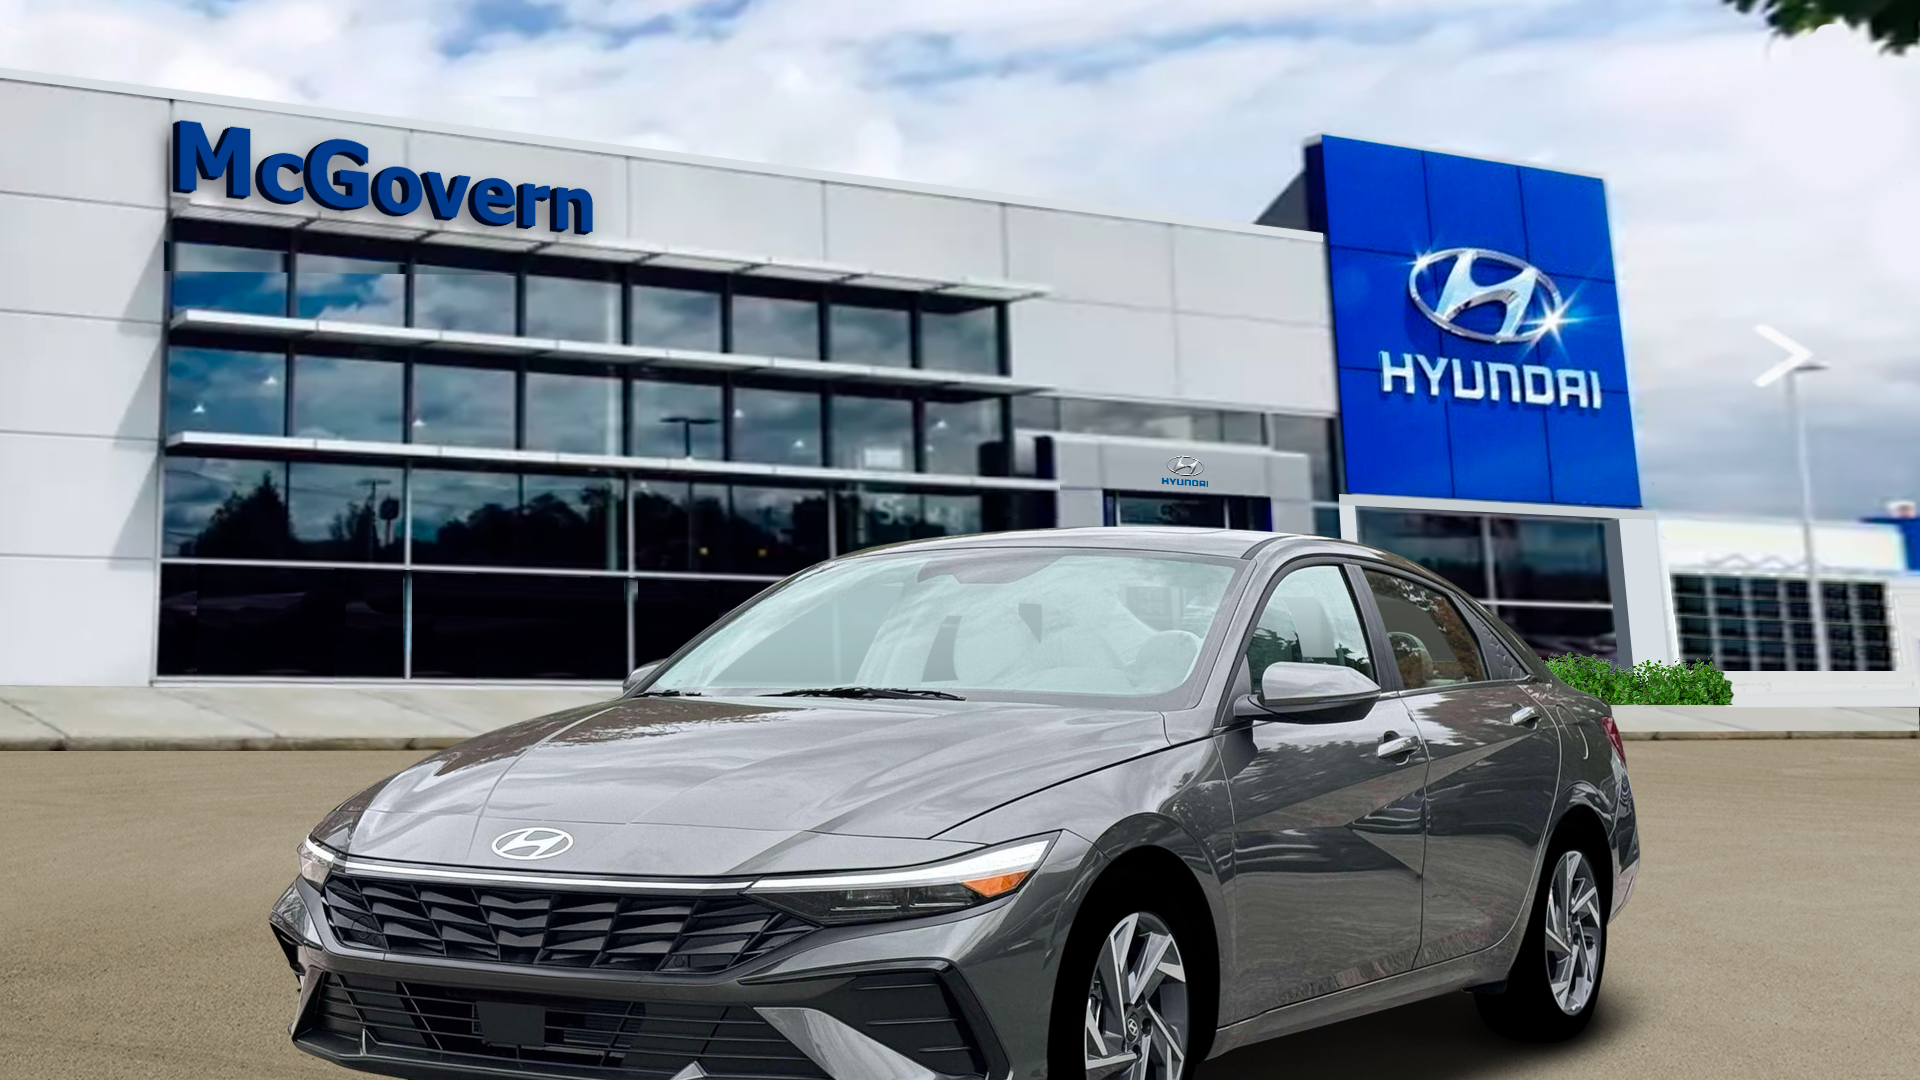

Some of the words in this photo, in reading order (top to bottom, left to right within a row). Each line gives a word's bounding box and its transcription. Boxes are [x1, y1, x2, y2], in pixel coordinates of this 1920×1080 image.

[172, 120, 594, 235] McGovern
[1379, 350, 1602, 409] HYUNDAI
[1161, 477, 1209, 488] HYUNDAI
